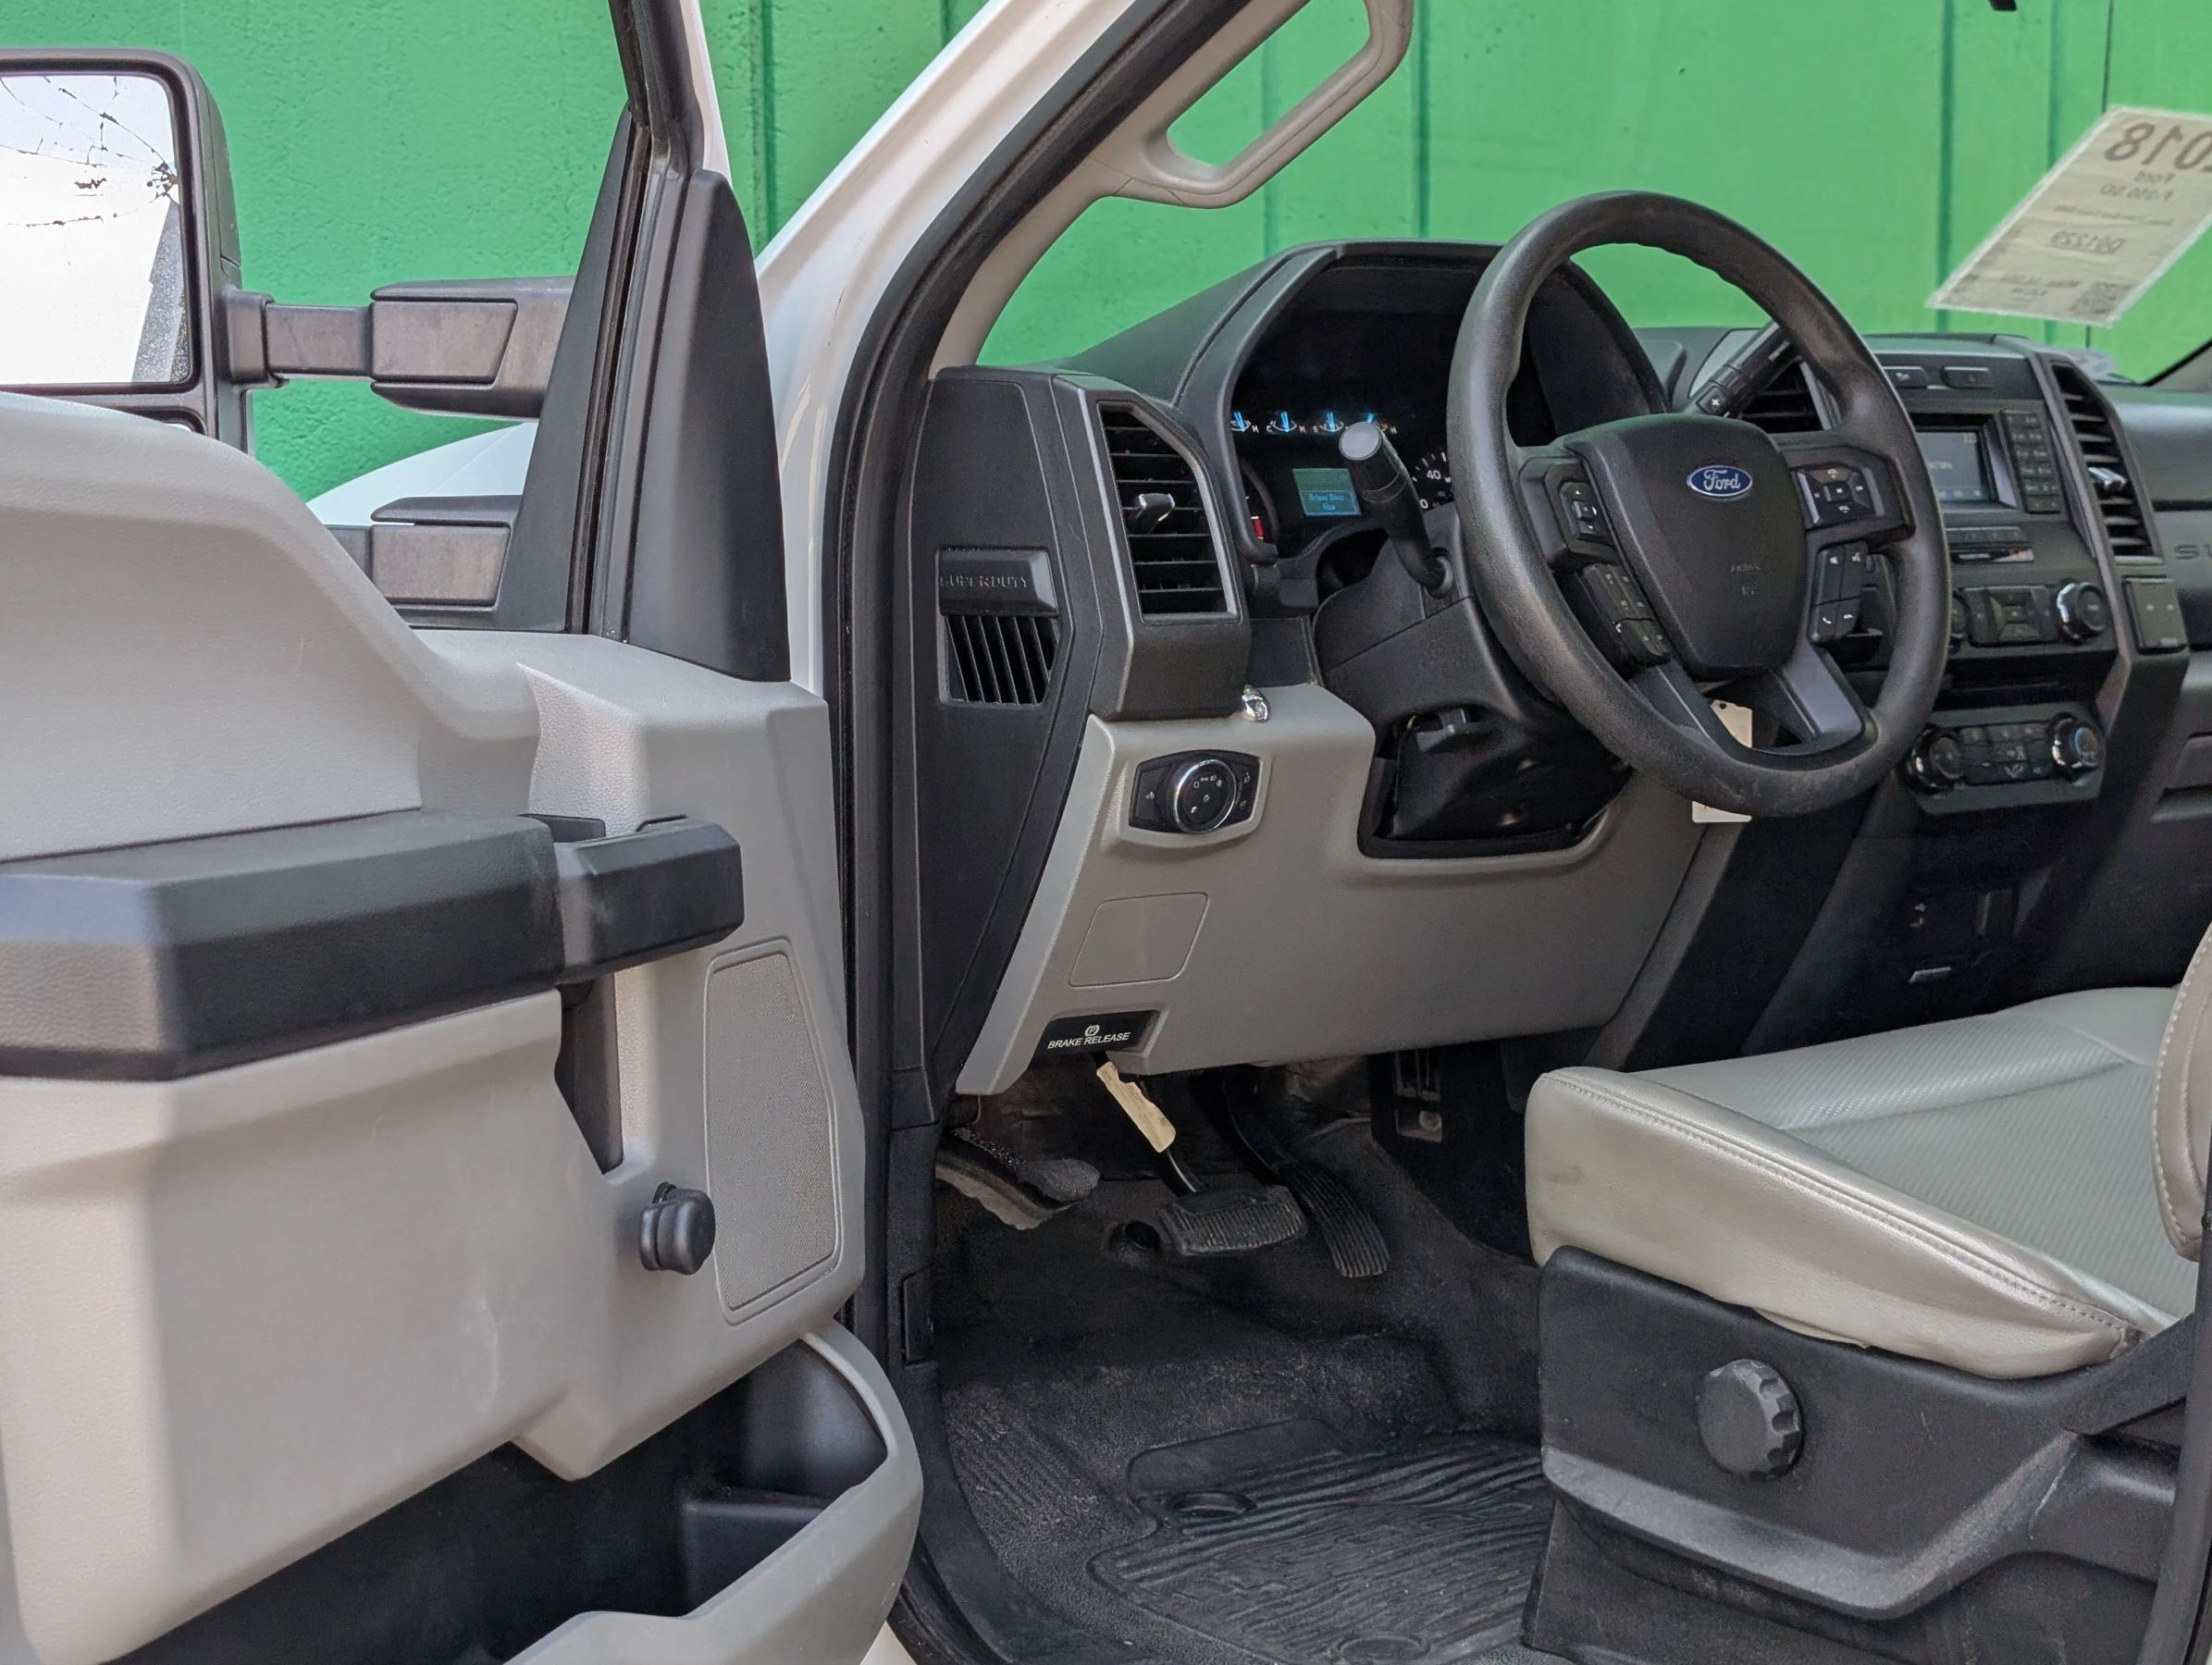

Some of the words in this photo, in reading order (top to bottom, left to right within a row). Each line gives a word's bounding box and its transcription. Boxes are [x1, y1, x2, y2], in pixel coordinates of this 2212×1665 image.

[1266, 425, 1273, 433] C
[1426, 469, 1441, 480] 40
[1702, 469, 1741, 491] Ford
[1047, 1037, 1083, 1050] BRAKE
[1083, 1031, 1131, 1046] RELEASE
